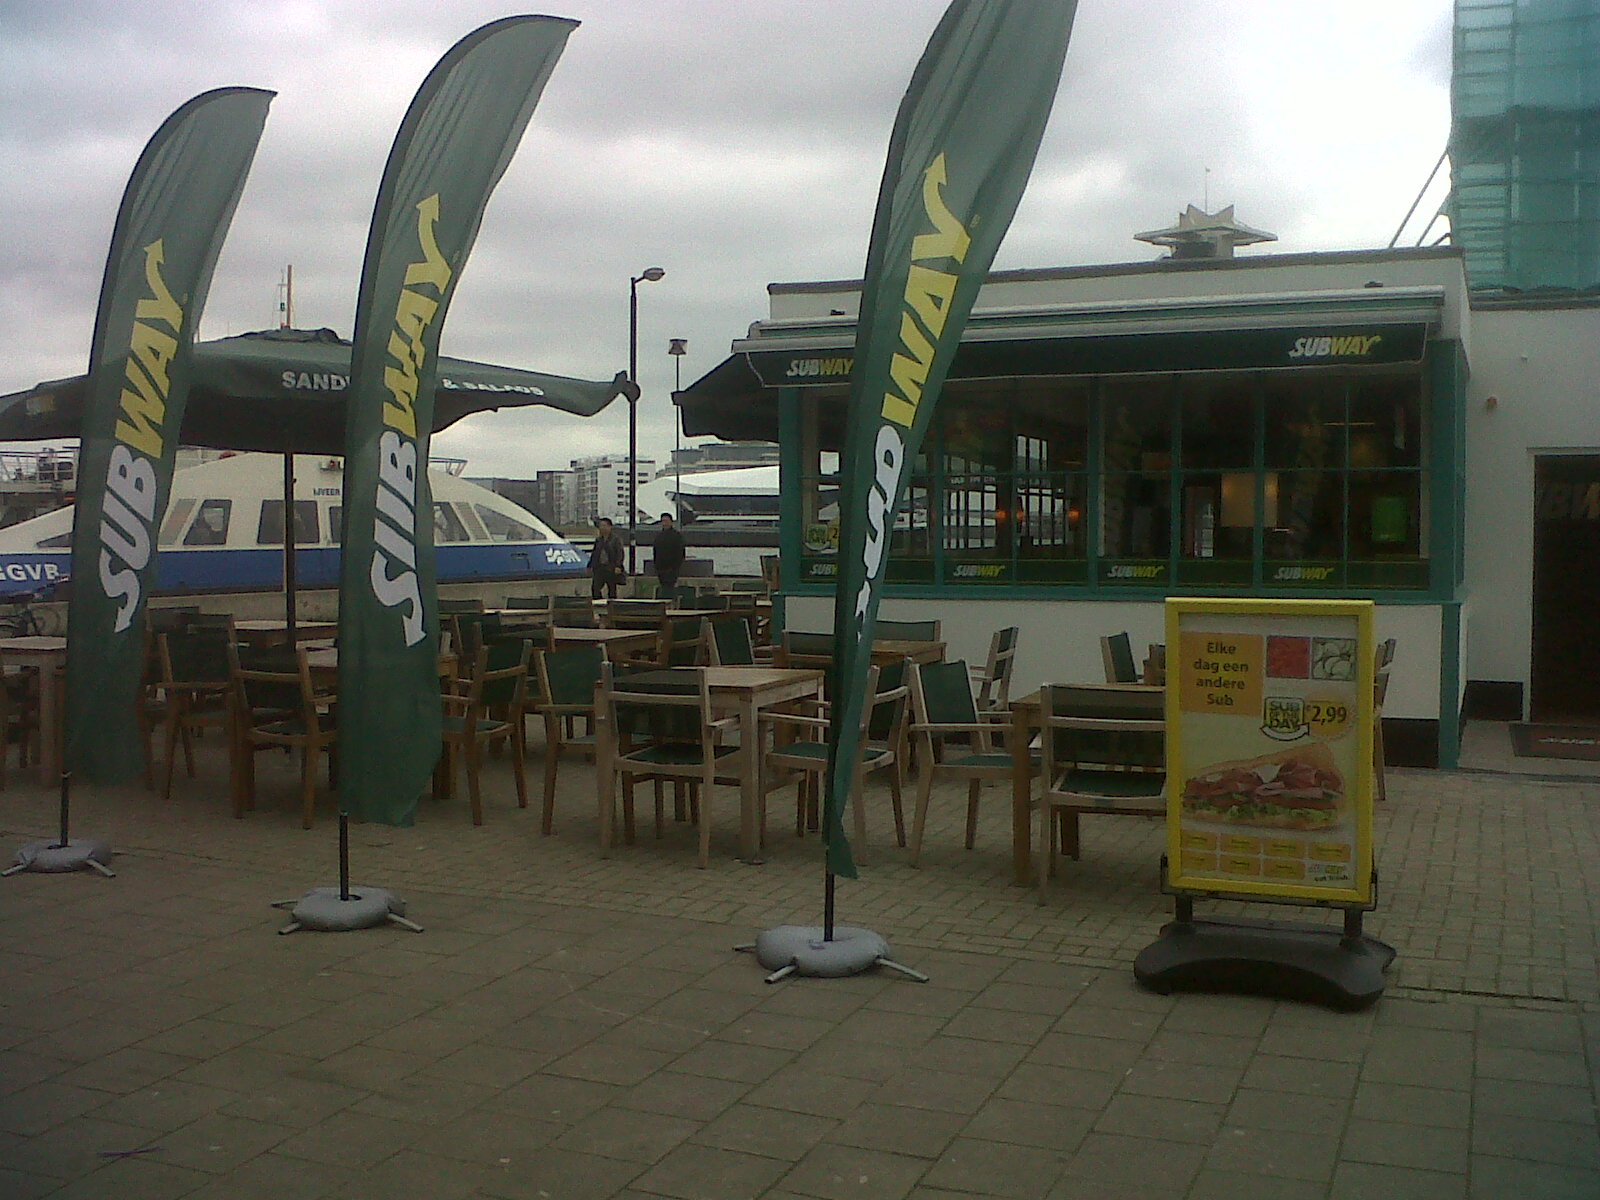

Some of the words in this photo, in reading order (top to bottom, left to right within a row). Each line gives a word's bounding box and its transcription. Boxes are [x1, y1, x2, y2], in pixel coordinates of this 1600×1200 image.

[1289, 334, 1381, 359] SUBWAY
[786, 358, 854, 377] SUBWAY
[281, 369, 351, 391] SAND
[370, 193, 453, 647] SUBWAY
[98, 238, 185, 634] SUBWAY
[953, 564, 1004, 578] SUBWAY
[1107, 564, 1166, 579] SUBWAY
[1274, 566, 1334, 581] SUBWAY
[1207, 641, 1236, 654] Elke
[1194, 658, 1219, 673] dag
[1223, 662, 1249, 672] een
[1196, 676, 1245, 689] andere
[1207, 693, 1234, 706] Sub
[1270, 700, 1300, 711] SUB
[1270, 718, 1299, 729] DAY
